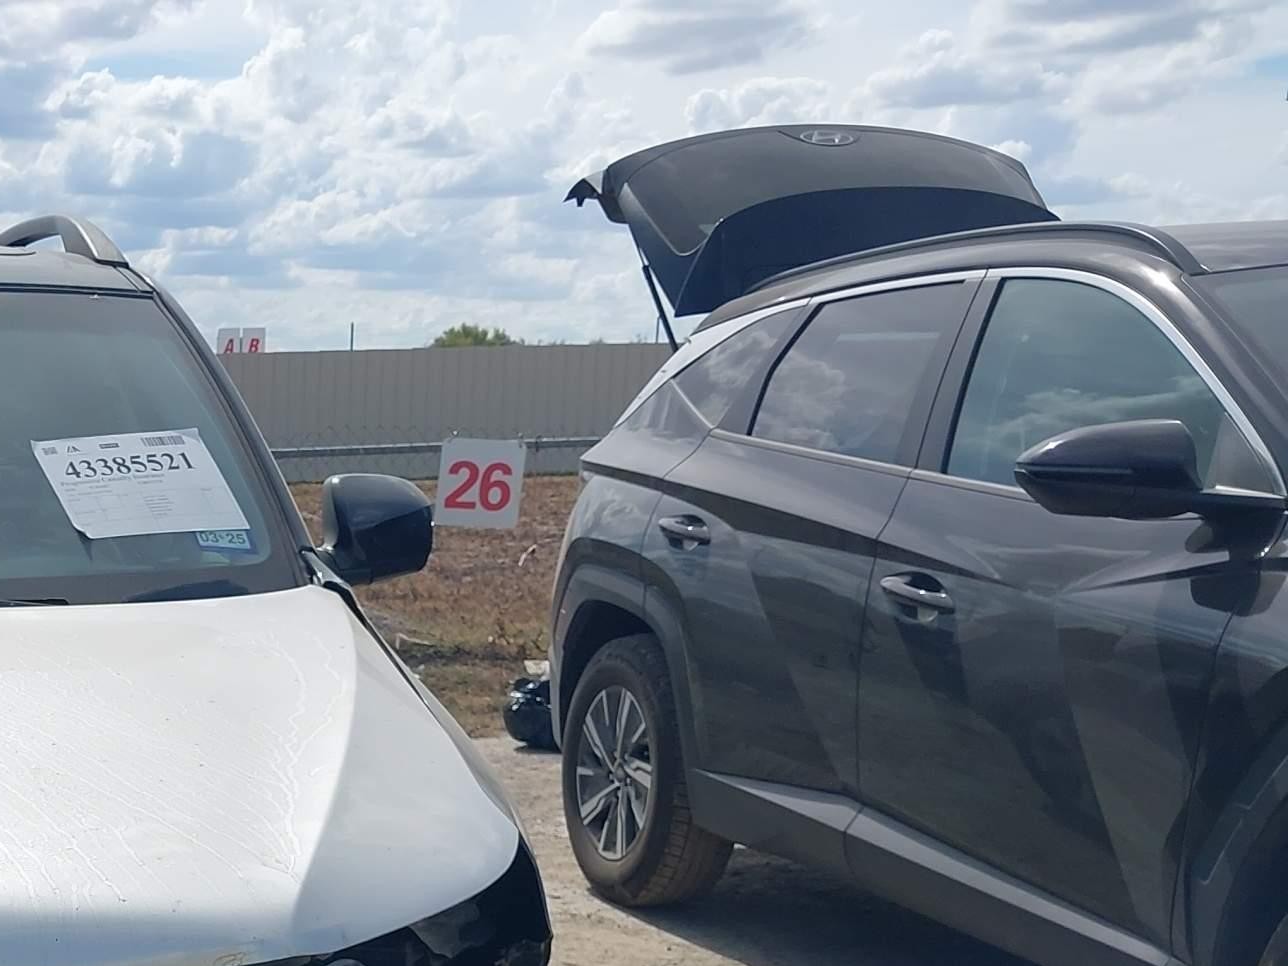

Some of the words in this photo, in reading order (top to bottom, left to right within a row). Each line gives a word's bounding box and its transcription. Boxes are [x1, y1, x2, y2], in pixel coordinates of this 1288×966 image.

[223, 337, 235, 353] A
[247, 337, 260, 353] B
[65, 452, 194, 479] 43385521
[444, 460, 513, 512] 26
